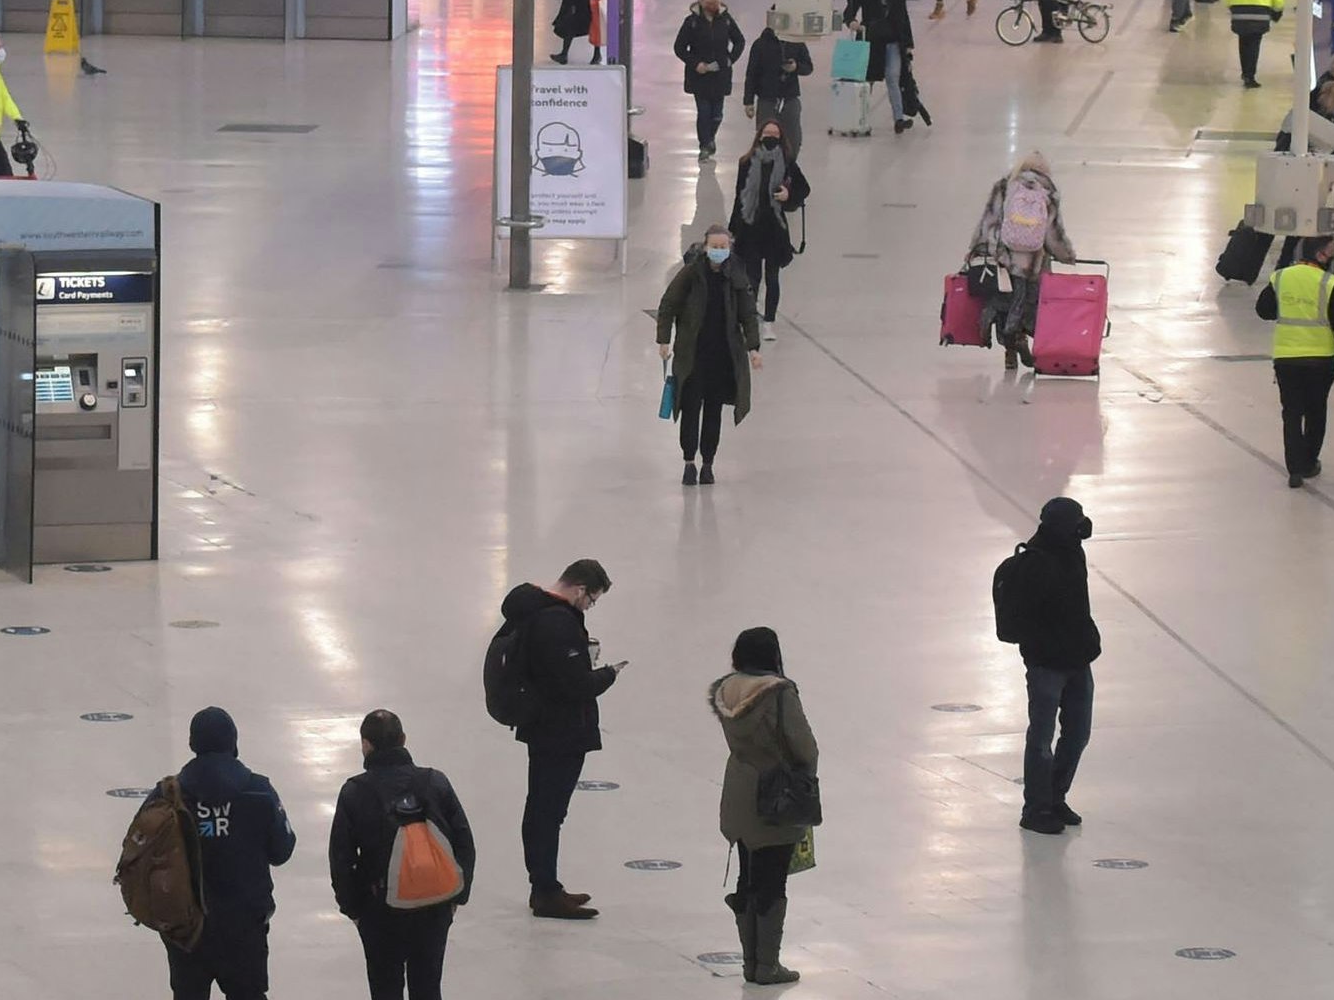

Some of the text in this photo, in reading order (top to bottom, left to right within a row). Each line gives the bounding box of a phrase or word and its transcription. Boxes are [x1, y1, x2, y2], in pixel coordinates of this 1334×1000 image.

[564, 85, 588, 94] with
[59, 277, 105, 288] TICKETS
[59, 290, 113, 299] Card Payments
[197, 802, 231, 818] SW
[216, 817, 229, 836] R
